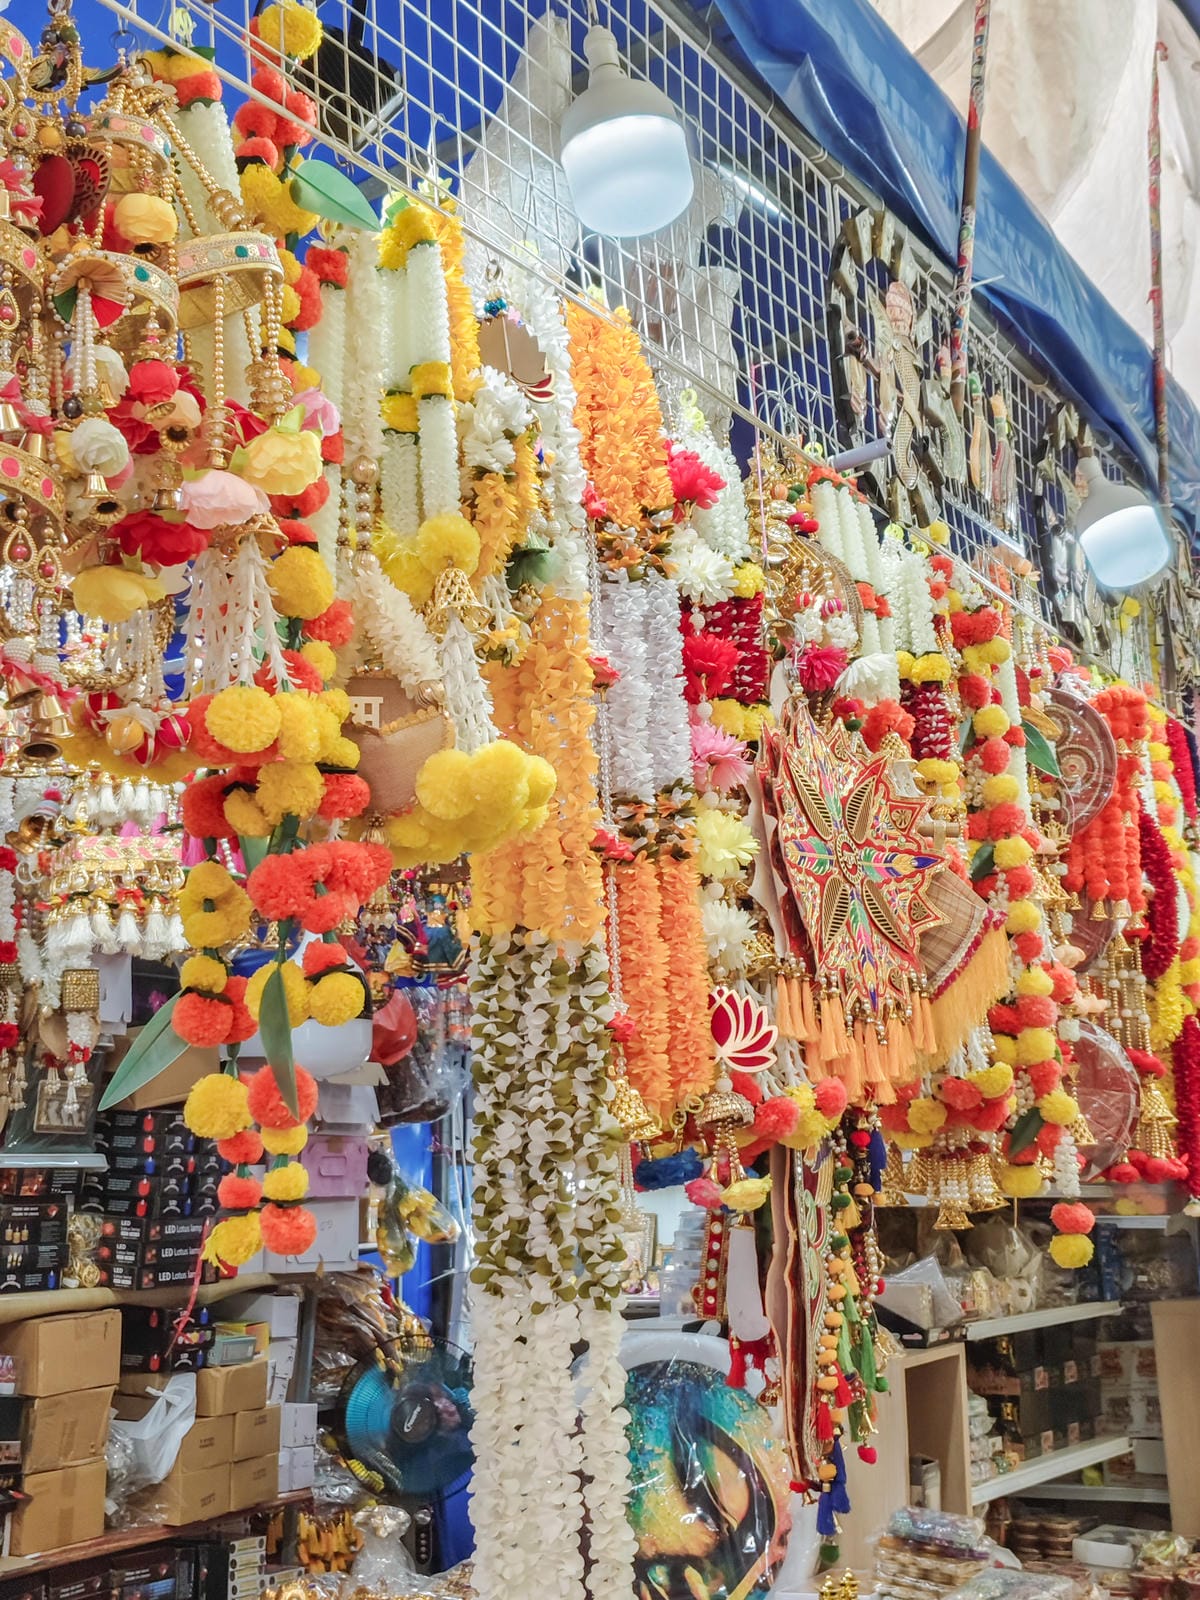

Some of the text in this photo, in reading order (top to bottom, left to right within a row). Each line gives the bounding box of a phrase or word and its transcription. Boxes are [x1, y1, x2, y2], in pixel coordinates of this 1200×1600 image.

[165, 1225, 176, 1234] LED
[177, 1224, 190, 1233] Lotus
[161, 1248, 174, 1258] LED
[174, 1247, 188, 1256] Lotus
[158, 1271, 171, 1281] LED
[172, 1271, 187, 1280] Lotus
